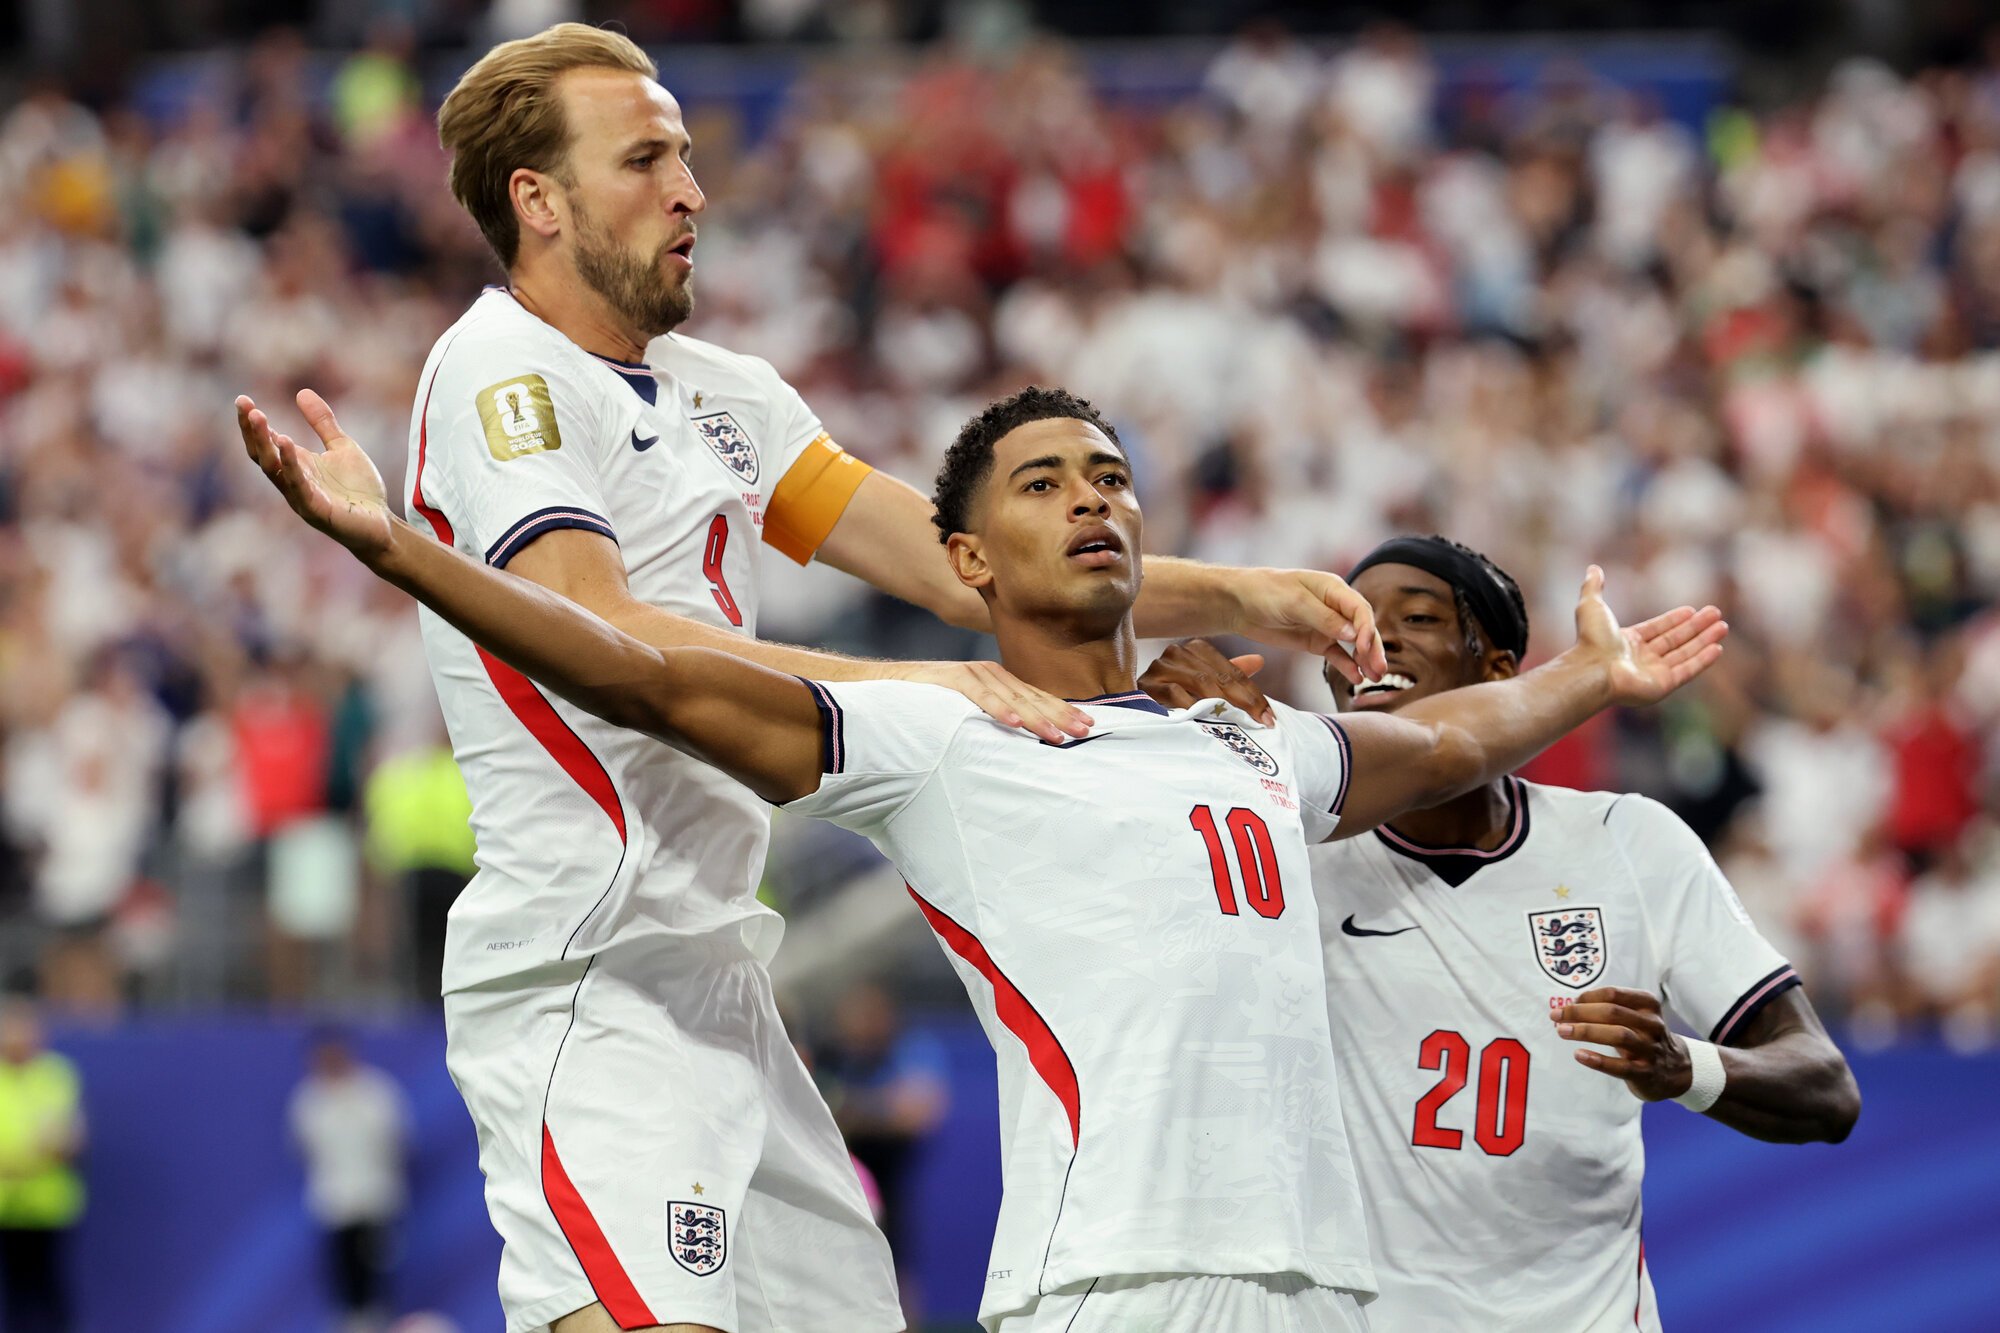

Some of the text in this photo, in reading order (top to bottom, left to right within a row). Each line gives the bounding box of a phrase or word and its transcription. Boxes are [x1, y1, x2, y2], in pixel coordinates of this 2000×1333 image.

[514, 422, 530, 432] FIFA
[508, 435, 529, 444] WORLD
[510, 438, 545, 453] 2026
[703, 514, 743, 627] 9
[1188, 804, 1286, 920] 10
[1550, 996, 1573, 1009] CRO
[1412, 1029, 1531, 1157] 20
